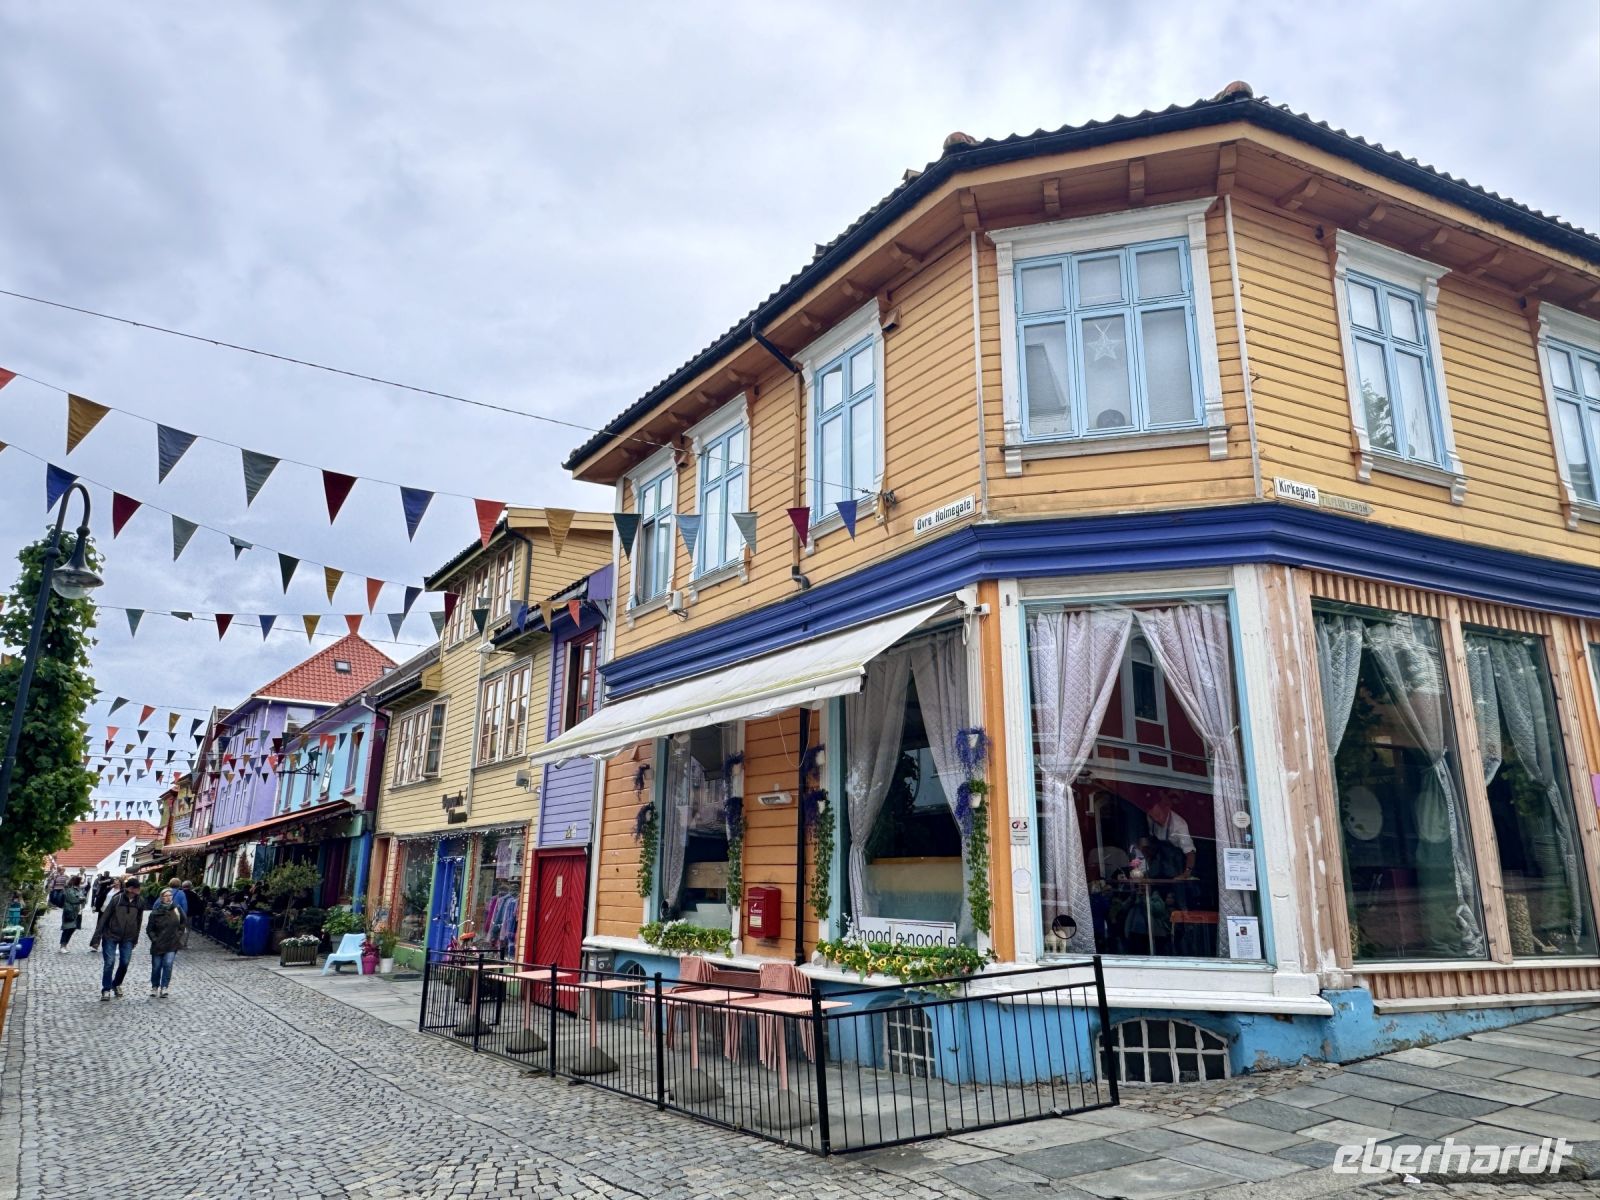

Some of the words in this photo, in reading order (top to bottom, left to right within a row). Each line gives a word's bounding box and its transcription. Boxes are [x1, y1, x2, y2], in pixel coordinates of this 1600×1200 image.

[1278, 480, 1316, 500] Kirkegata
[917, 516, 932, 531] Øvre
[935, 500, 971, 523] Holmegate
